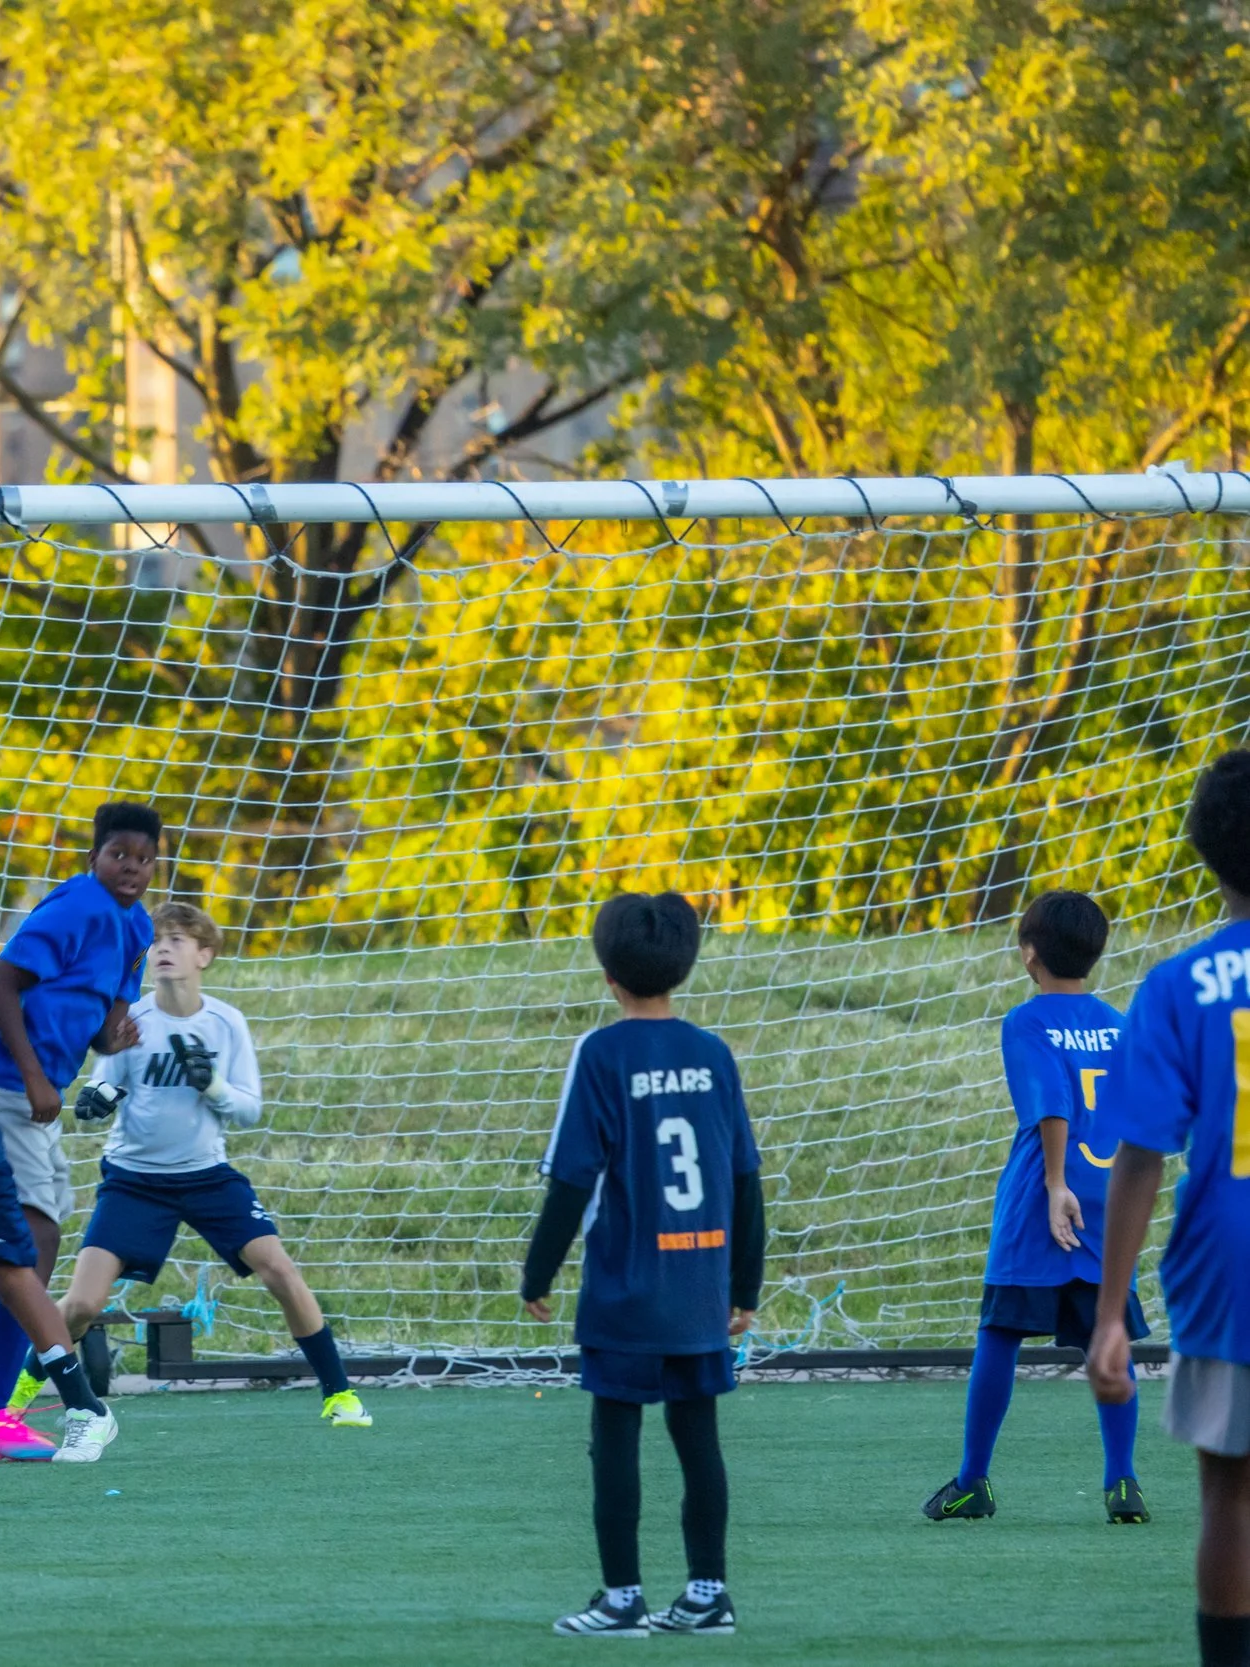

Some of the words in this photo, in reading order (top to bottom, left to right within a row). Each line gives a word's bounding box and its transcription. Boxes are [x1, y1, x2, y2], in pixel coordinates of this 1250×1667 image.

[1191, 950, 1250, 1004] SP
[631, 1067, 713, 1098] BEARS
[656, 1117, 704, 1212] 3
